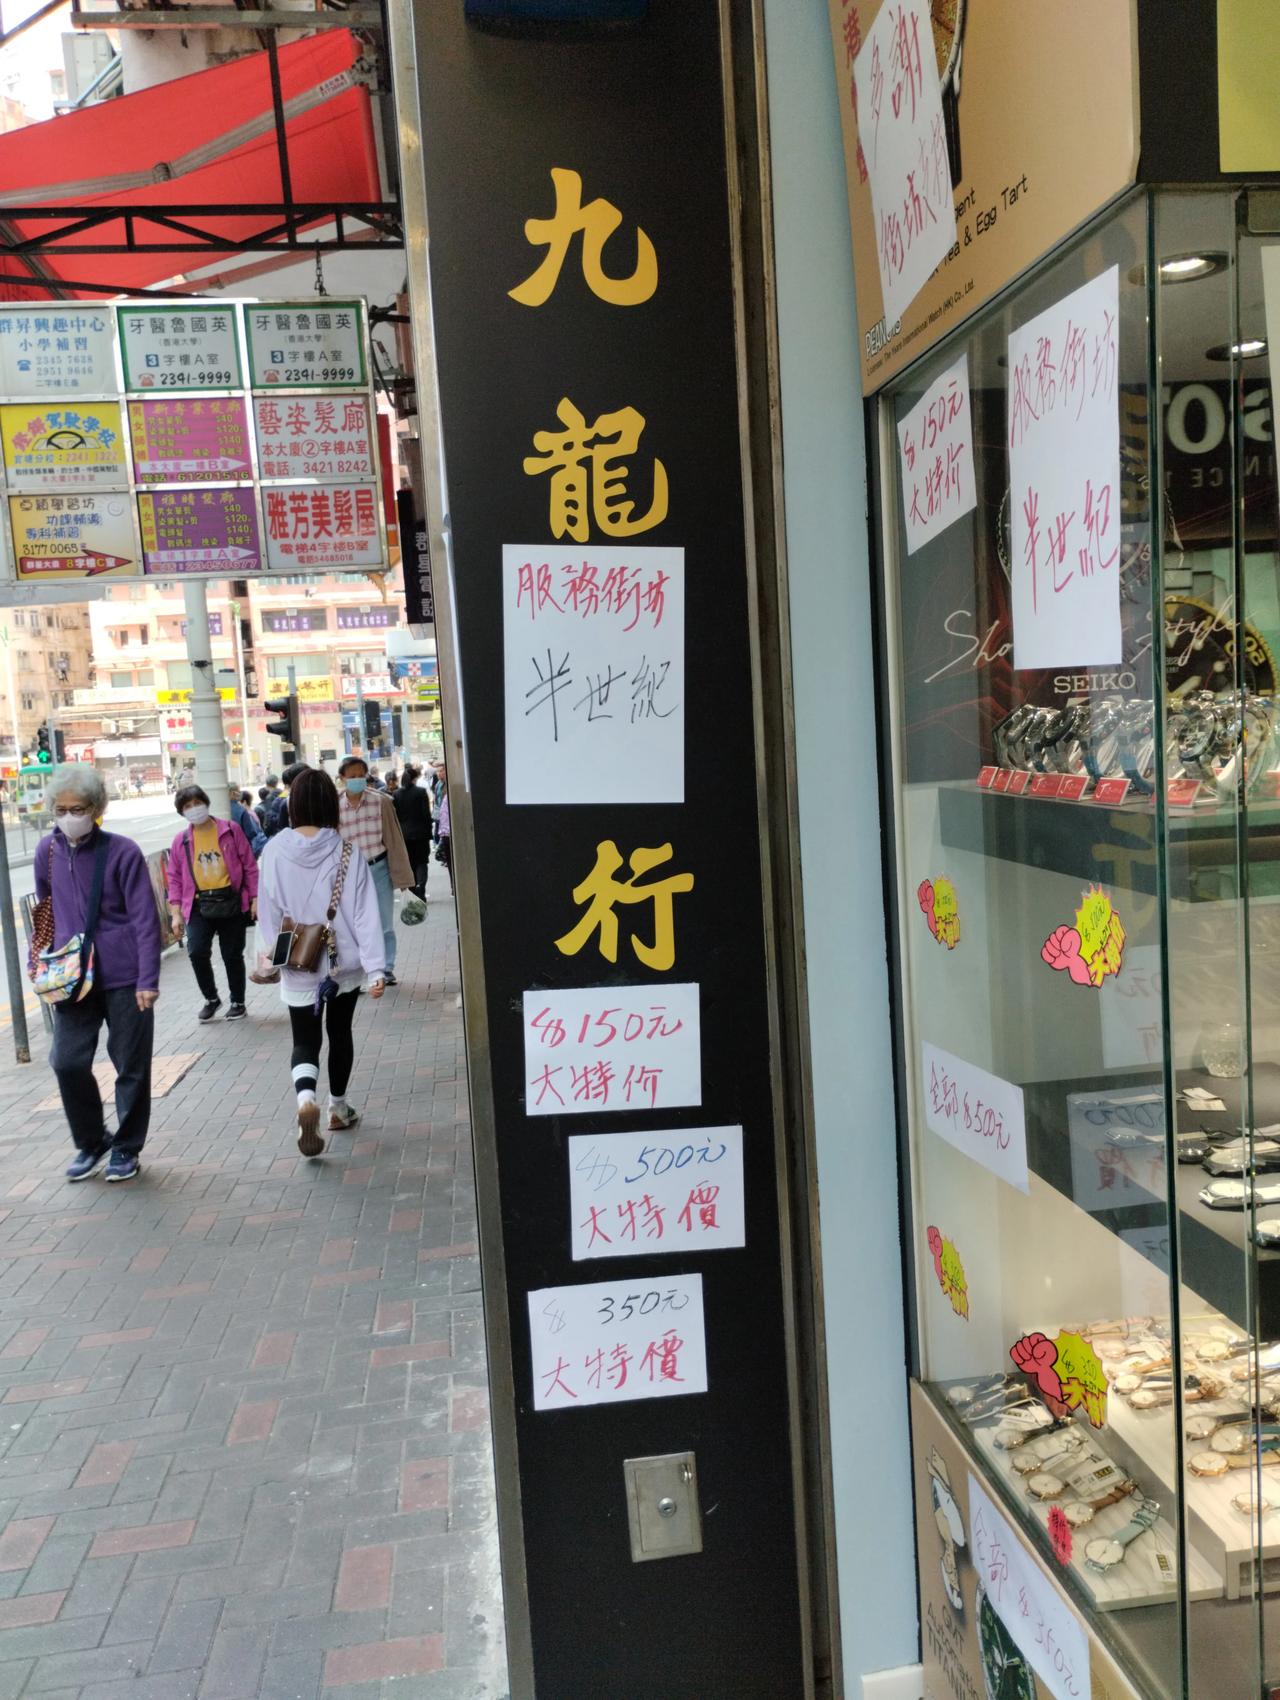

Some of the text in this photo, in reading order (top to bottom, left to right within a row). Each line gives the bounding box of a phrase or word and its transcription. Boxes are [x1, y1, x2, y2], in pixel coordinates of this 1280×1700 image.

[976, 206, 997, 237] Egg
[1001, 173, 1029, 212] Tart
[128, 316, 228, 335] 牙醫魯國英
[255, 312, 352, 331] 牙醫魯國英
[160, 370, 232, 385] 2341-9999
[284, 367, 354, 382] 2341-9999
[1011, 310, 1116, 448] 服務街坊
[258, 400, 366, 435] 藝姿髮廊
[303, 461, 333, 474] 3421
[337, 459, 368, 473] 8242
[507, 167, 695, 971] 九龍行
[1022, 478, 1119, 617] 半世紀
[516, 561, 671, 632] 服務街坊
[924, 610, 1014, 684] Sho
[525, 648, 679, 742] 半世紀
[1052, 671, 1137, 695] SEIKO
[580, 1180, 721, 1249] 大特價
[541, 1328, 686, 1399] 大特價
